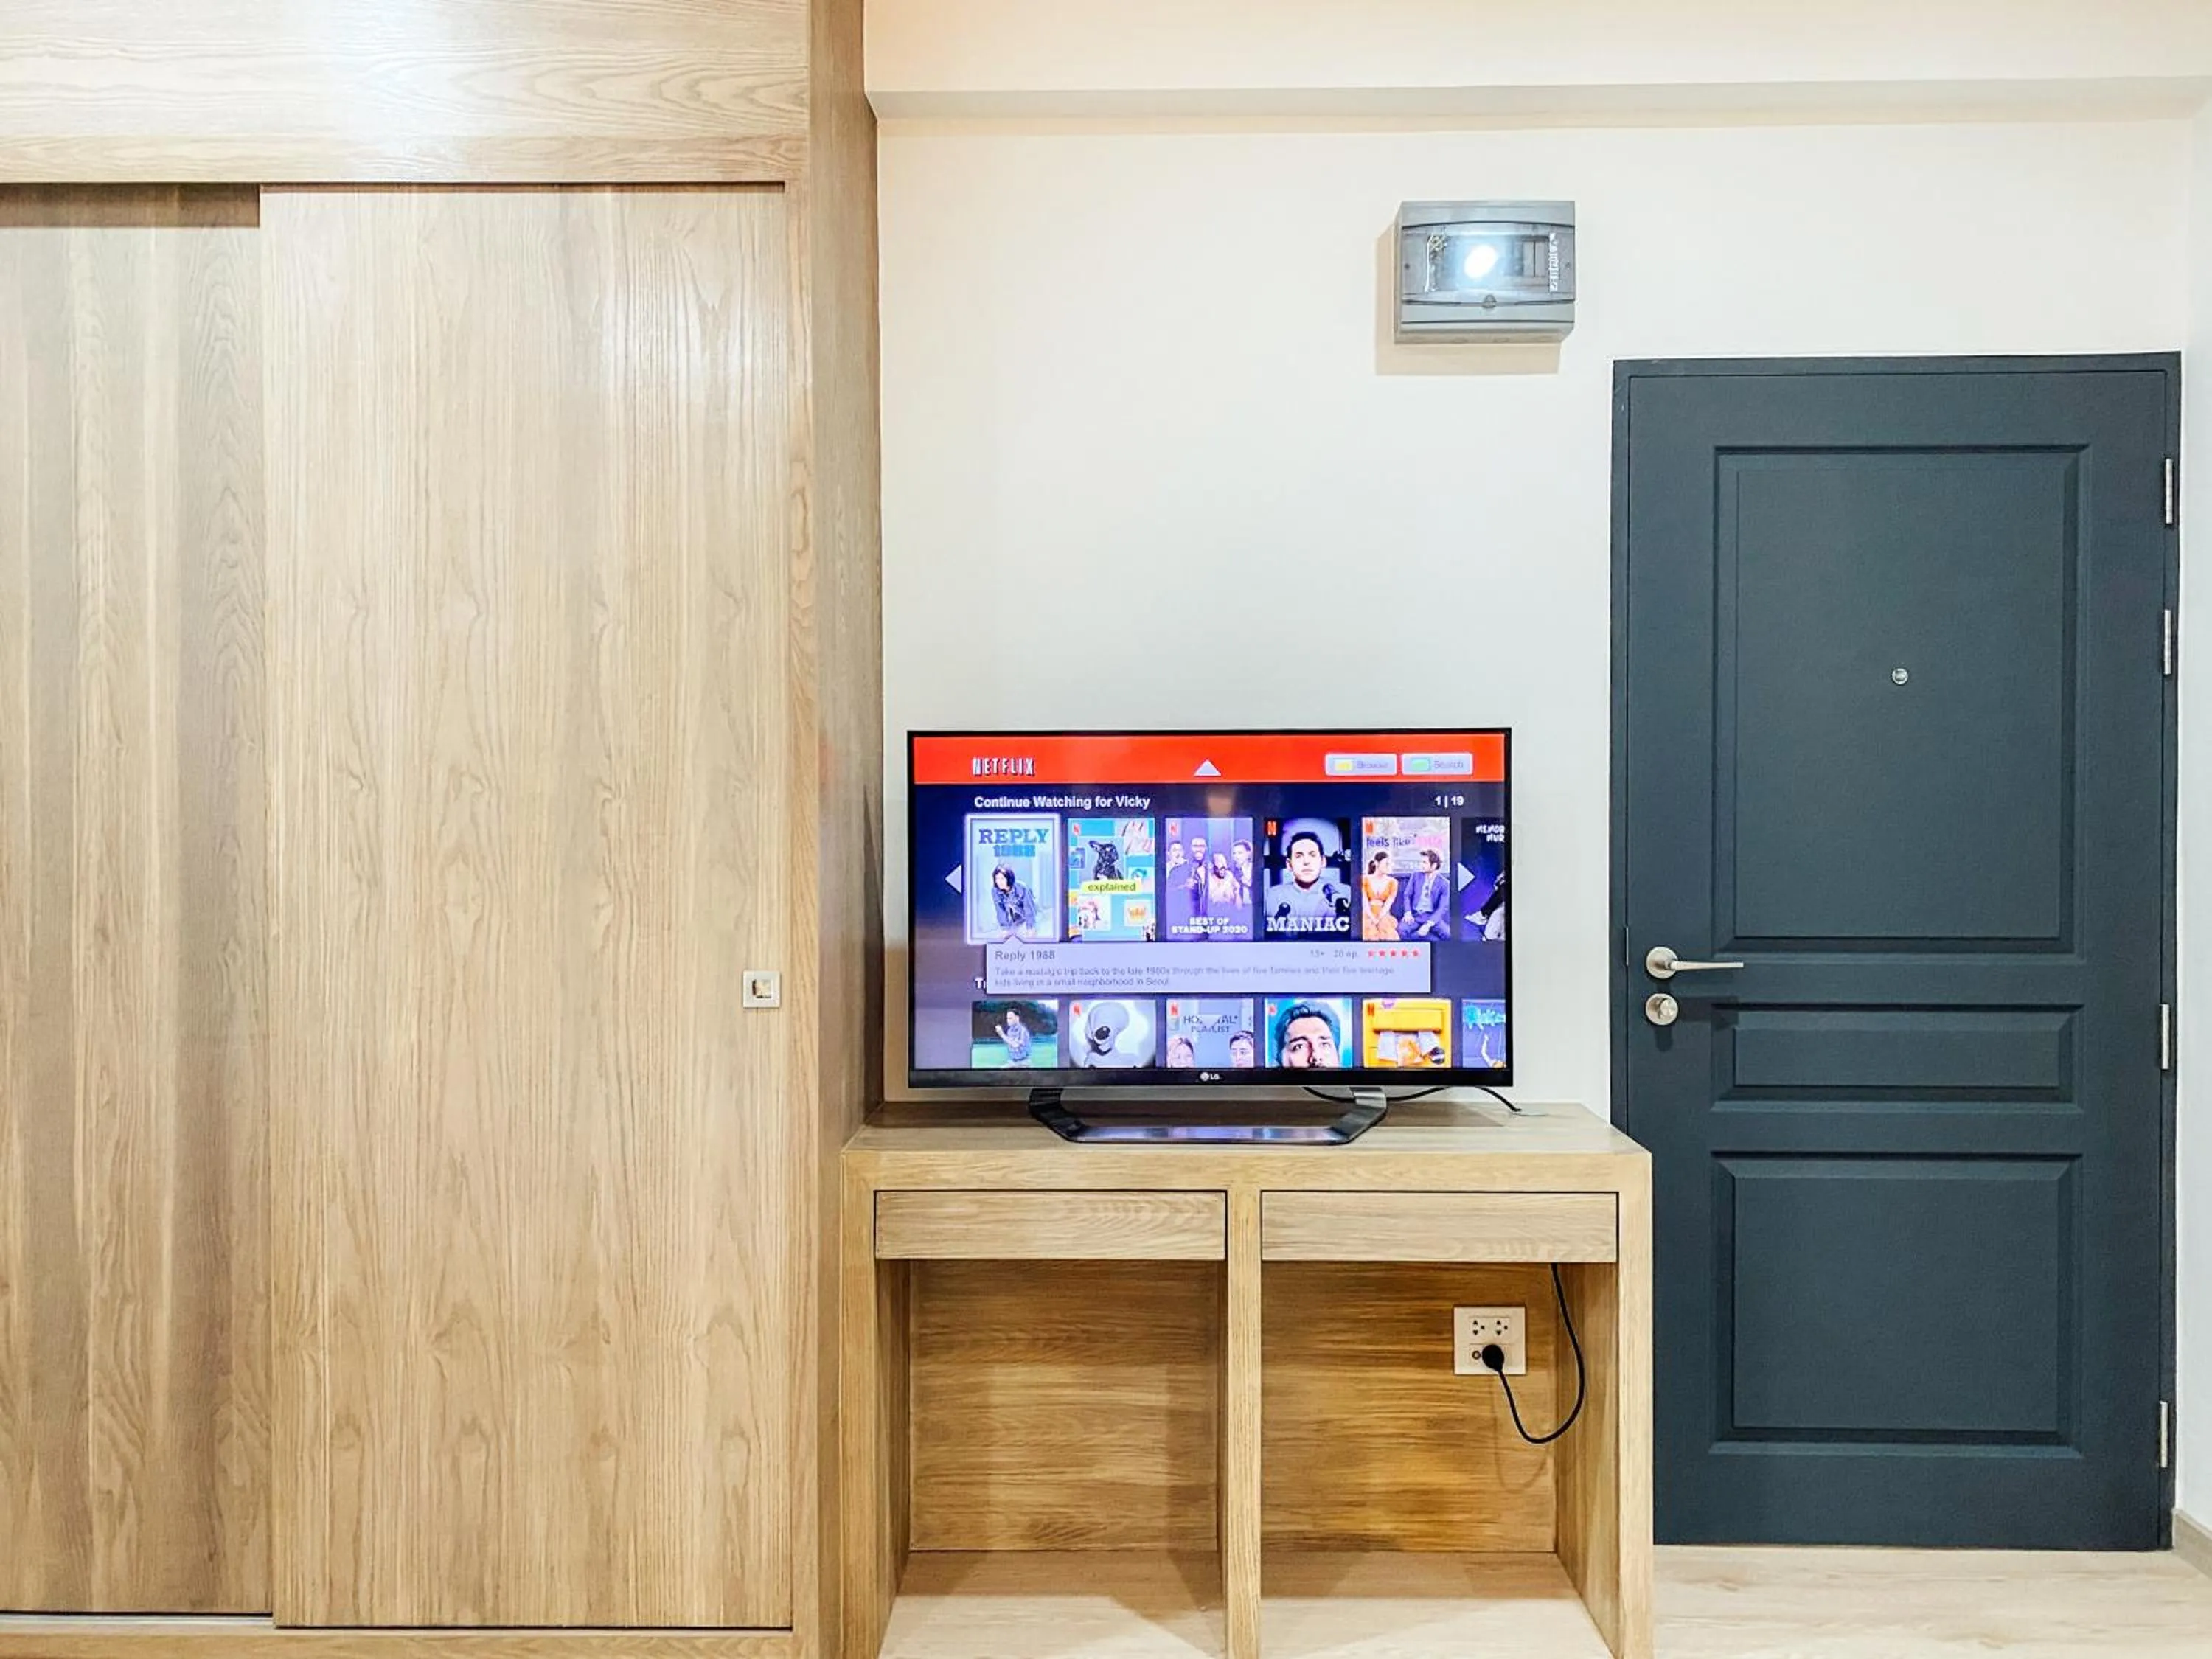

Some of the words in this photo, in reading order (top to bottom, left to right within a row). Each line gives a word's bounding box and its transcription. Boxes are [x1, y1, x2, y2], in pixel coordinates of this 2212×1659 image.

[972, 757, 1035, 776] NETFLIX
[974, 796, 1030, 808] Continue
[1033, 796, 1093, 810] Watching
[1095, 796, 1113, 807] for
[1116, 796, 1151, 810] Vicky
[978, 829, 1048, 844] REPLY
[1088, 883, 1136, 894] explained
[1189, 917, 1214, 925] BEST
[1217, 917, 1229, 925] OF
[1266, 917, 1350, 932] MANIAC
[1223, 925, 1248, 933] 2020
[995, 950, 1026, 961] Reply
[1031, 950, 1055, 959] 1988
